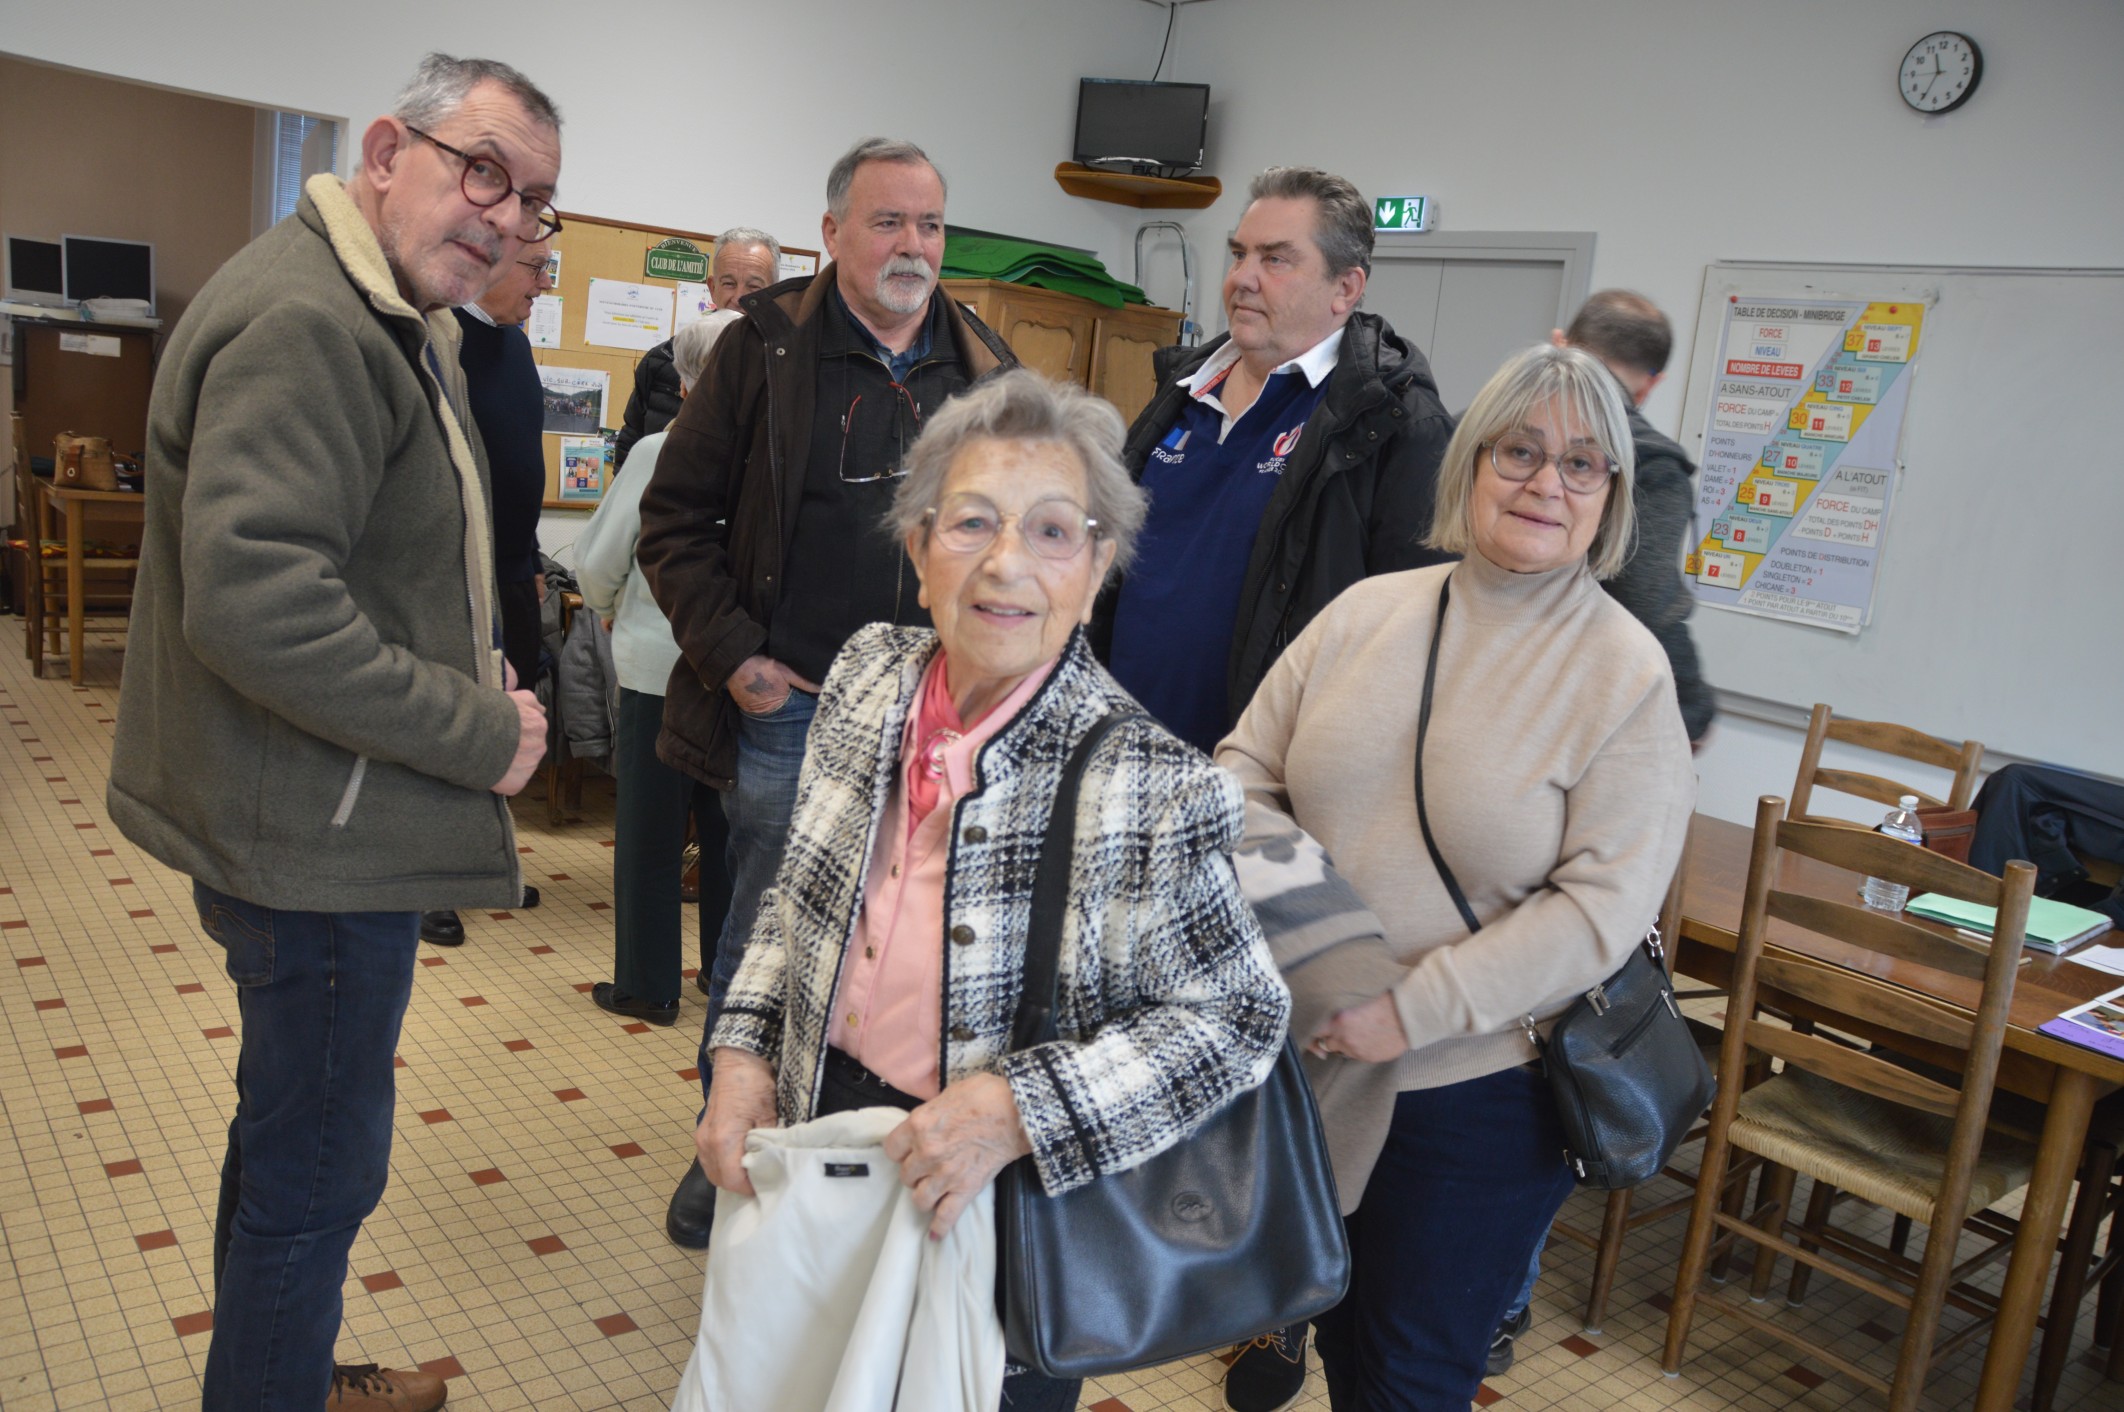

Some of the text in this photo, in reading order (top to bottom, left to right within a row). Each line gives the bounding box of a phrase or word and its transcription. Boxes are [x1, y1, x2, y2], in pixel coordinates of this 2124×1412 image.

[1927, 46, 1935, 54] 11
[1939, 40, 1948, 49] 12
[1954, 43, 1958, 52] 1
[1916, 56, 1925, 64] 10
[1961, 53, 1967, 61] 2
[1910, 70, 1916, 78] 9
[1963, 67, 1969, 75] 3
[1912, 83, 1918, 92] 8
[1956, 81, 1962, 89] 4
[1932, 96, 1938, 104] 6
[1946, 91, 1951, 100] 5
[651, 257, 704, 274] CLUB DE L'AMITIÉ
[1734, 307, 1755, 317] TABLE
[1756, 308, 1765, 318] DE
[1766, 308, 1798, 319] DECISION
[1803, 310, 1846, 321] MINIBRIDGE
[1760, 327, 1783, 338] FORCE
[1846, 334, 1865, 346] 37
[1870, 341, 1880, 350] 13
[1755, 346, 1781, 357] NIVEAU
[1730, 362, 1799, 376] NOMBRE DE LEVEES
[1818, 374, 1834, 387] 33
[1721, 384, 1792, 398] A SANS-ATOUT
[1842, 382, 1852, 392] 12
[1717, 402, 1747, 414] FORCE
[1791, 412, 1808, 425] 30
[1815, 420, 1822, 429] 11
[1716, 419, 1733, 427] TOTAL
[1744, 422, 1763, 430] POINTS
[1764, 421, 1771, 431] H
[1711, 437, 1736, 446] POINTS
[1709, 449, 1752, 462] D'HONNEURS
[1765, 450, 1781, 462] 27
[1706, 464, 1727, 472] VALET
[1787, 458, 1796, 468] 10
[1705, 474, 1723, 484] DAME
[1729, 477, 1735, 485] 2
[1835, 470, 1888, 486] A L'ATOUT
[1703, 486, 1714, 494] ROI
[1720, 488, 1726, 496] 3
[1739, 486, 1754, 500] 25
[1816, 498, 1849, 512] FORCE
[1850, 506, 1861, 514] DU
[1714, 522, 1729, 536] 23
[1808, 516, 1826, 524] TOTAL
[1826, 518, 1840, 526] DES
[1840, 520, 1862, 530] POINTS
[1863, 520, 1879, 531] DH
[1801, 527, 1824, 536] POINTS
[1824, 527, 1832, 538] D
[1837, 531, 1860, 542] POINTS
[1861, 532, 1869, 542] H
[1687, 557, 1702, 570] 20
[1781, 547, 1869, 568] POINTS DE DISTRIBUTION
[1771, 560, 1812, 574] DOUBLETON
[1763, 571, 1801, 584] SINGLETON
[1807, 578, 1813, 586] 2
[1755, 581, 1785, 593] CHICANE
[1756, 592, 1778, 601] POINTS
[1779, 595, 1796, 604] POUR
[1797, 598, 1805, 606] LE
[1816, 601, 1836, 611] ATOUT
[1748, 598, 1766, 607] POINT
[1766, 601, 1780, 609] PAR
[1780, 604, 1799, 613] ATOUT
[1805, 608, 1828, 618] PARTIR
[1828, 612, 1838, 620] DU
